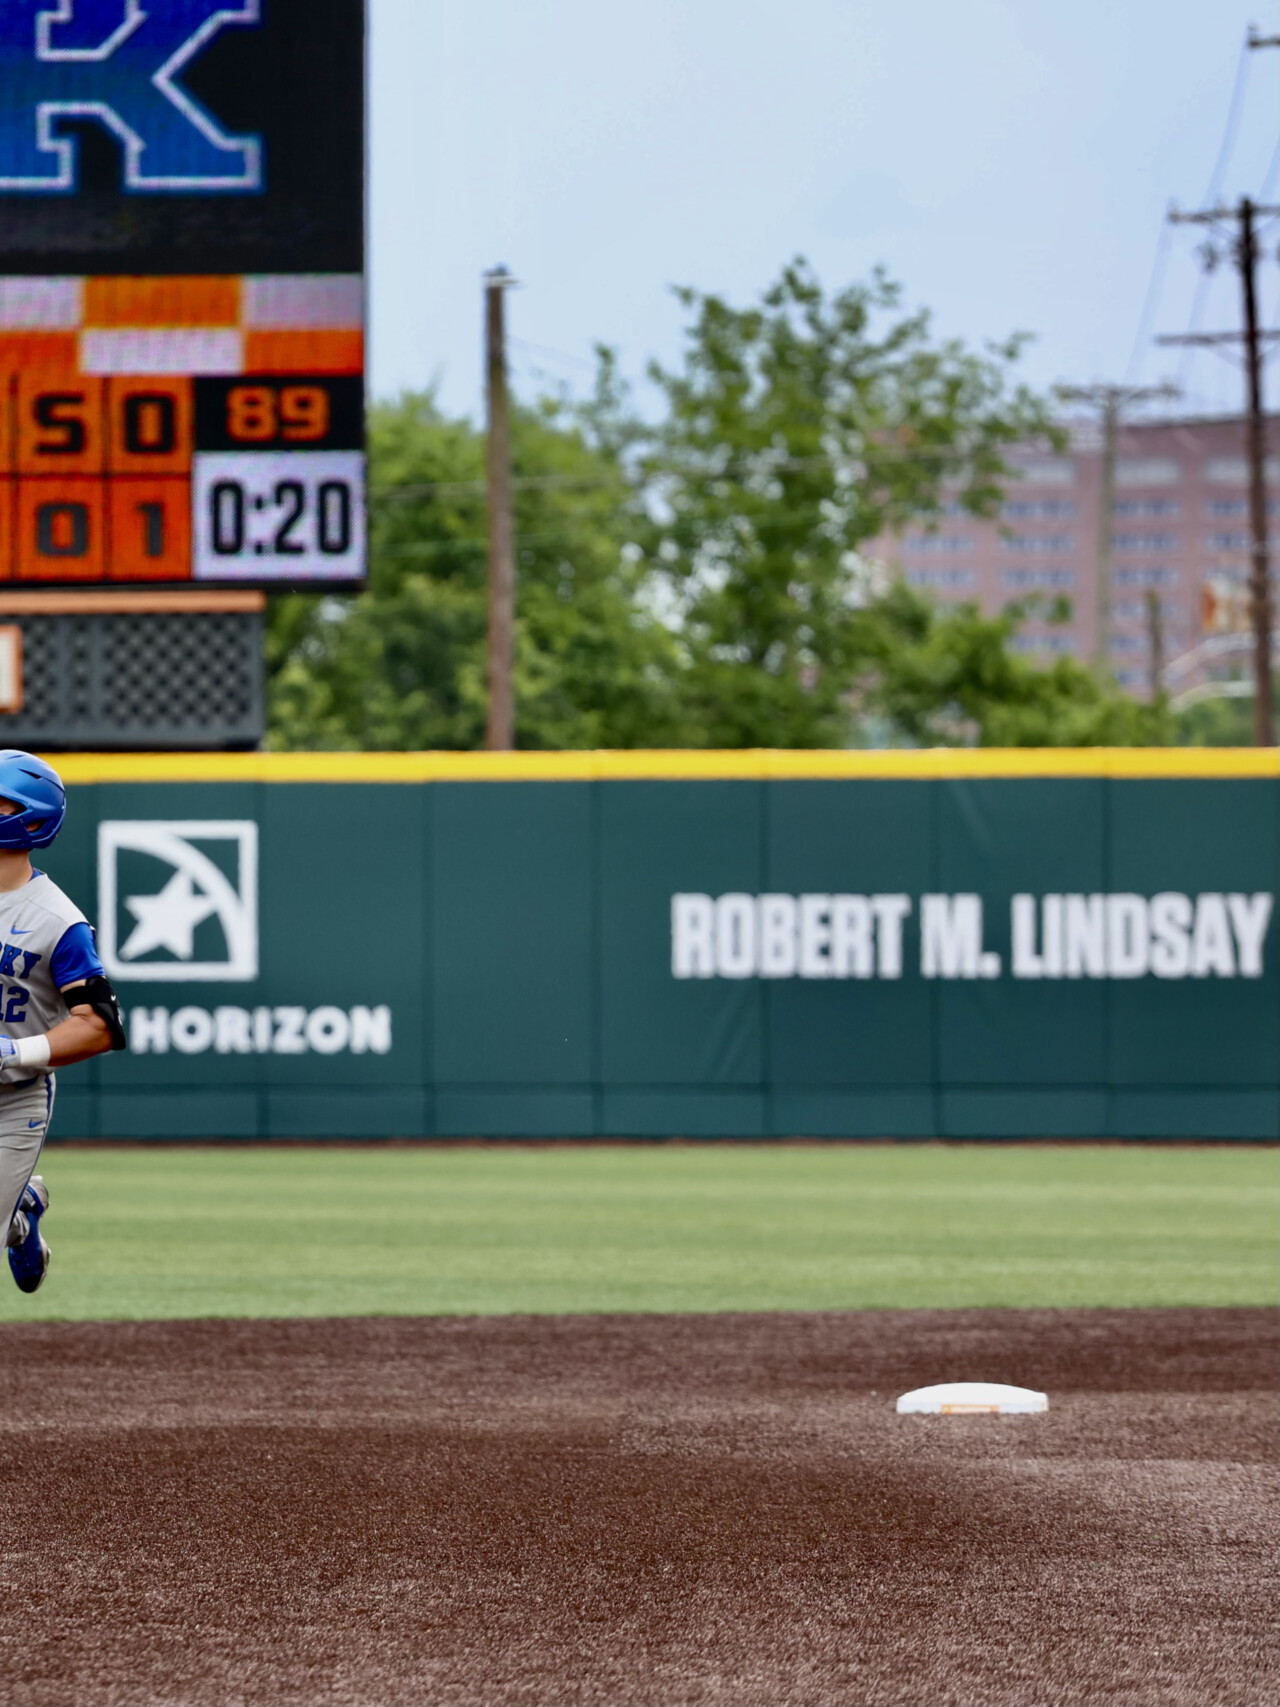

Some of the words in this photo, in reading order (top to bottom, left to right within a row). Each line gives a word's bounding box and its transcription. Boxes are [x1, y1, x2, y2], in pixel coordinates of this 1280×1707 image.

[32, 393, 87, 456] S
[227, 387, 328, 441] 89
[33, 499, 92, 559] 0
[135, 498, 167, 559] 1
[208, 478, 352, 558] 0:20
[671, 892, 911, 979] ROBERT
[920, 893, 1001, 979] M.
[1011, 892, 1273, 979] LINDSAY
[130, 1003, 393, 1055] HORIZON
